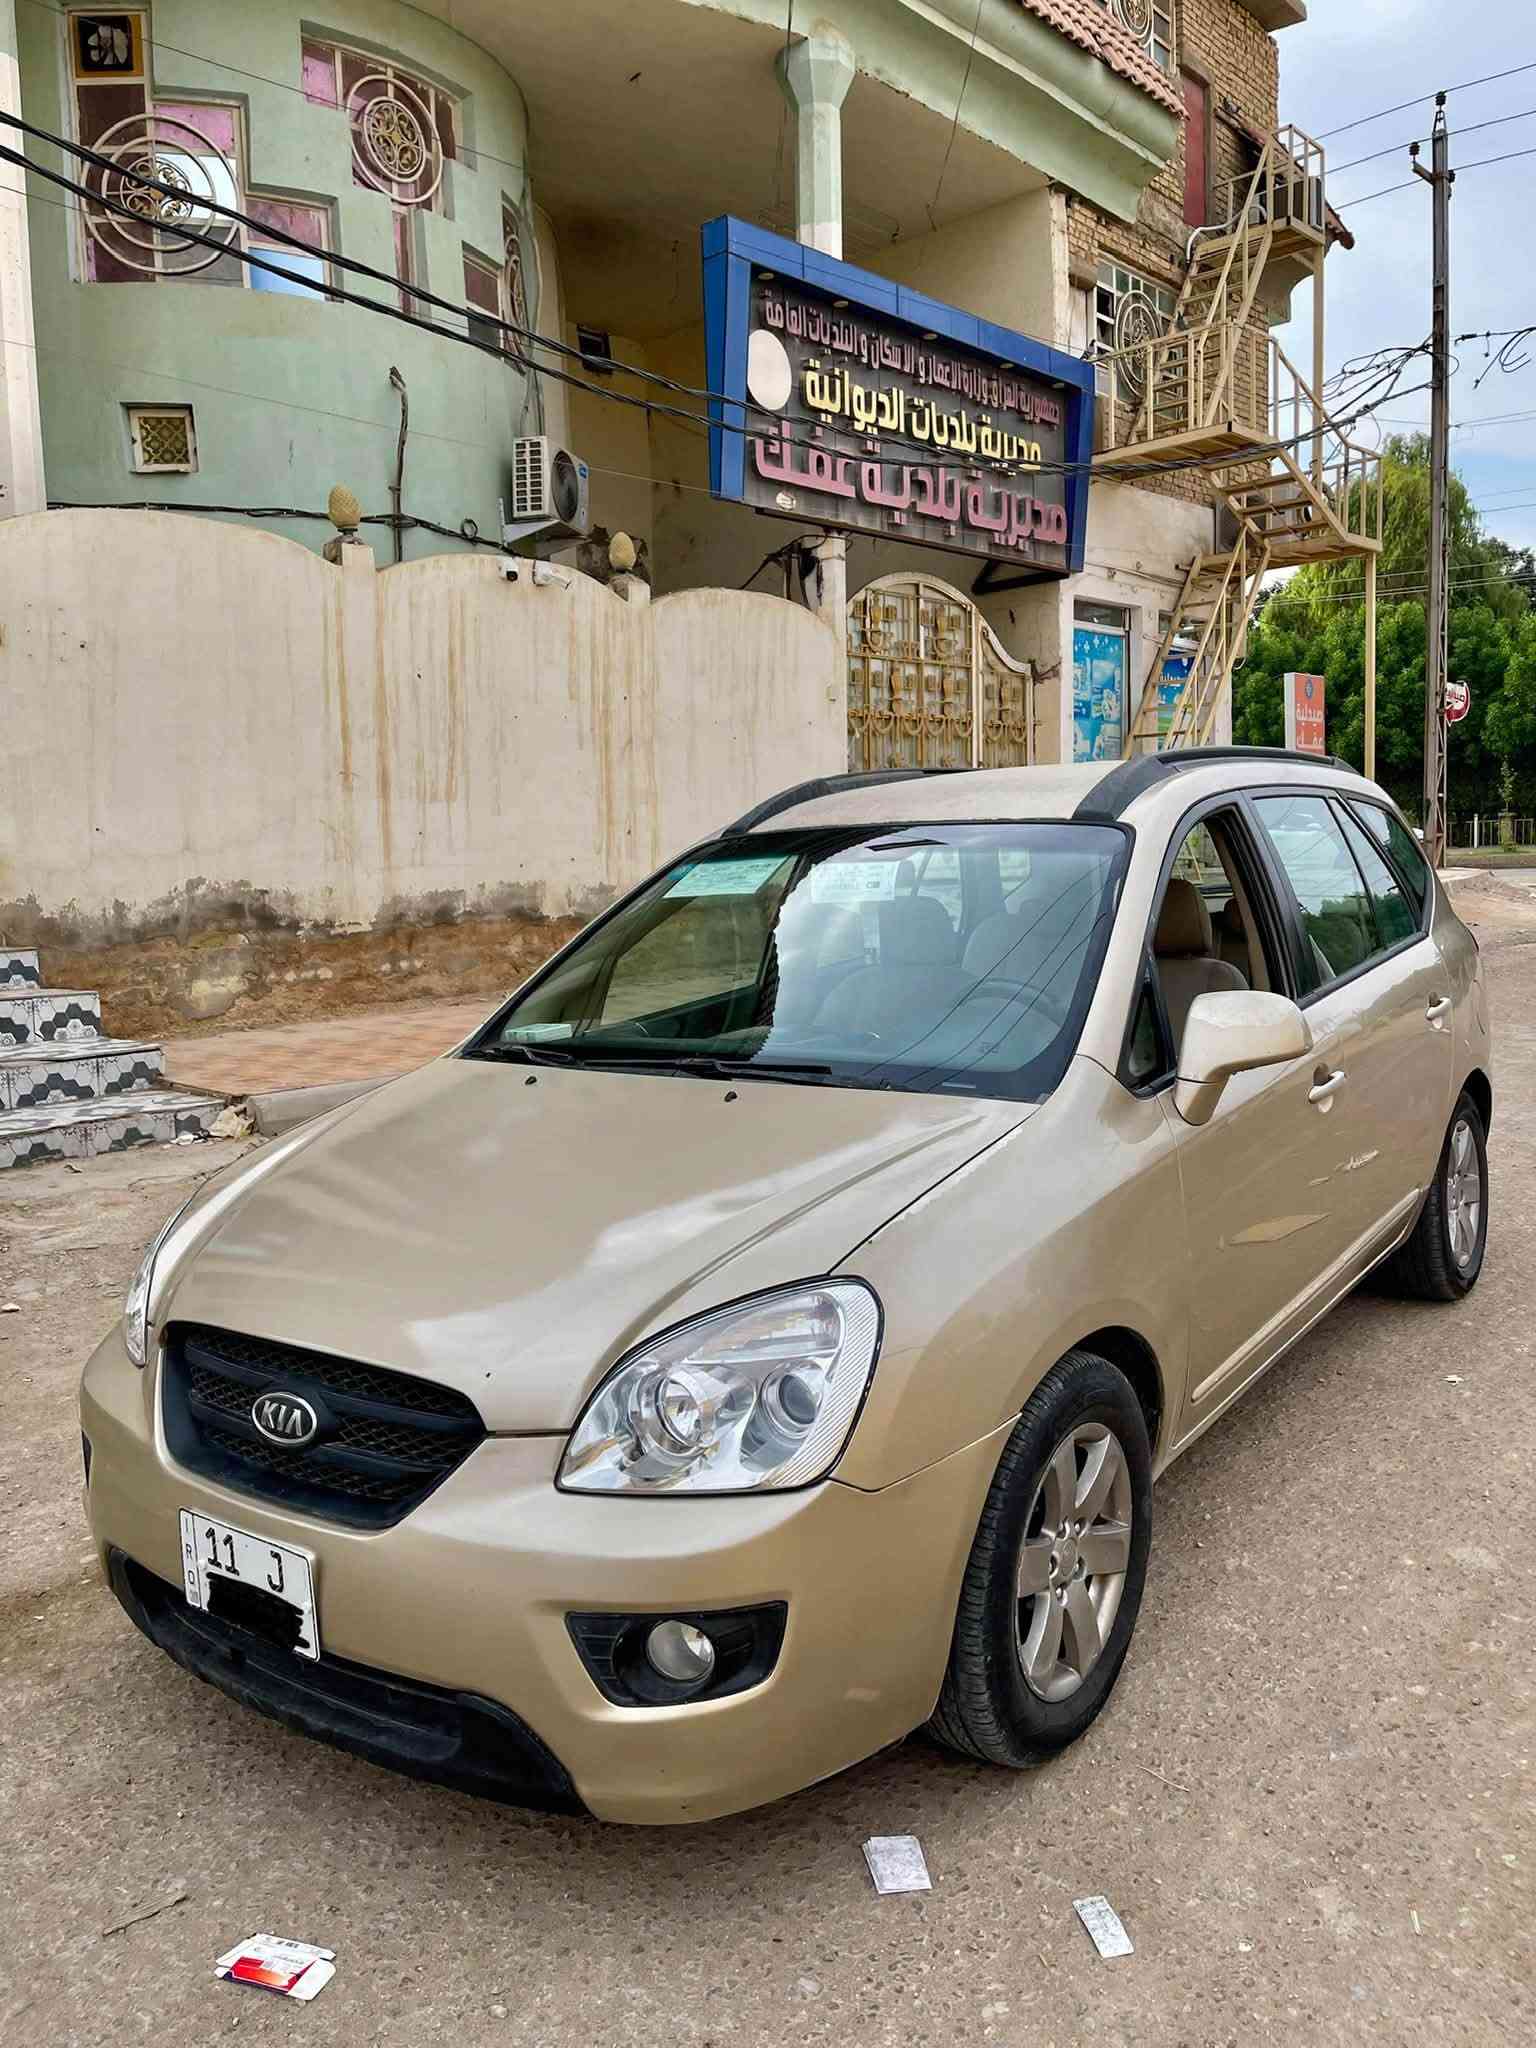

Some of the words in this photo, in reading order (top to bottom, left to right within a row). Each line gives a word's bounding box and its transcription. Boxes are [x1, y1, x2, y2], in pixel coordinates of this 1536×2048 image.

[764, 289, 807, 337] العامة
[808, 307, 858, 361] البلديات
[805, 358, 904, 435] الديوانية
[911, 398, 976, 461] بلديات
[981, 414, 1041, 476] مديرية
[861, 439, 960, 536] بلدية
[967, 469, 1067, 550] مديرية
[261, 1400, 302, 1437] KIA
[205, 1527, 240, 1577] 11
[267, 1550, 285, 1593] J
